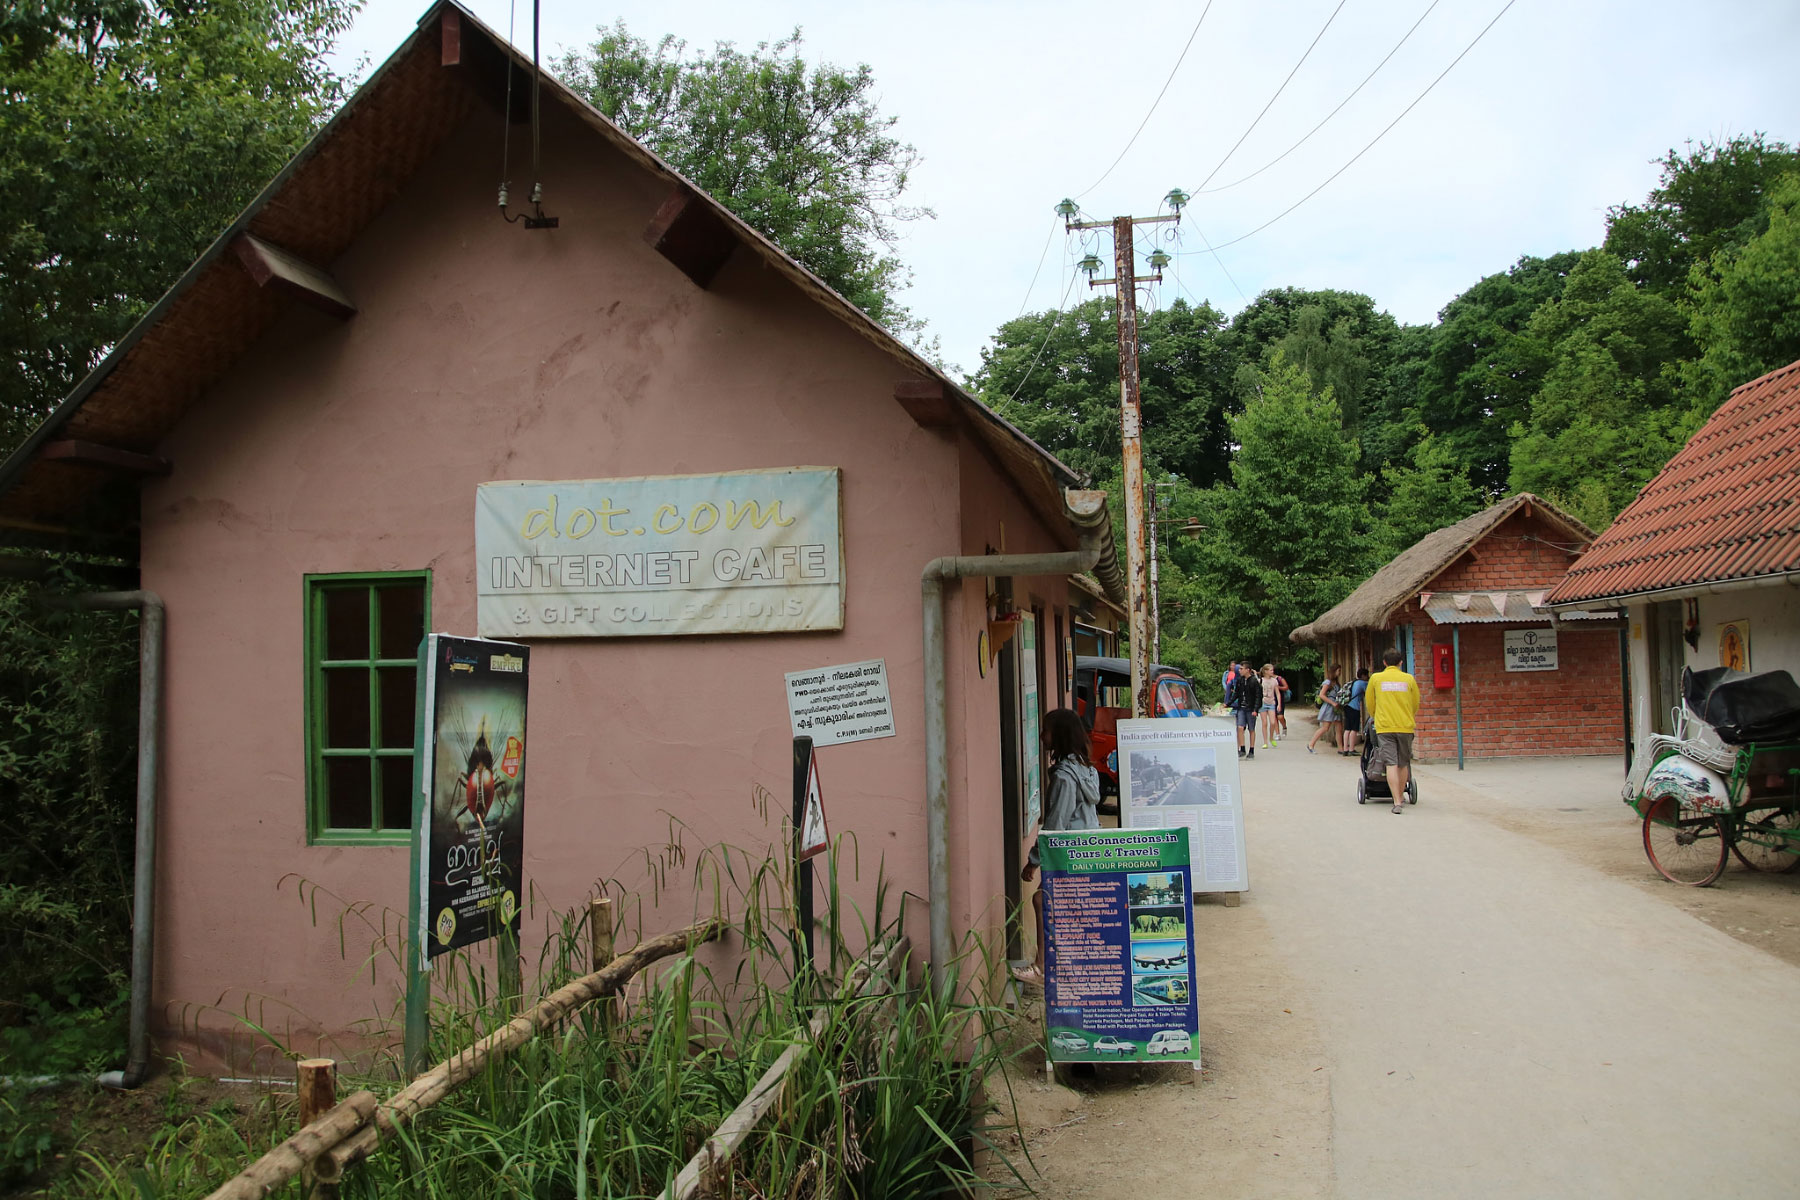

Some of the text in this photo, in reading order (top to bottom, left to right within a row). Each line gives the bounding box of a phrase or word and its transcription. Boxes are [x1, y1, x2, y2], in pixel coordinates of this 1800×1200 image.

[520, 494, 795, 540] dot.com
[492, 544, 826, 588] INTERNET CAFE
[512, 596, 804, 624] & GIFT COLLECTIONS
[492, 660, 522, 672] EMPIRE
[1121, 729, 1232, 742] India geeft olifanten vrije baan
[1049, 834, 1178, 847] KeralaConnections.in
[1068, 846, 1160, 860] Tours & Travels
[1072, 861, 1158, 871] DAILY TOUR PROGRAM
